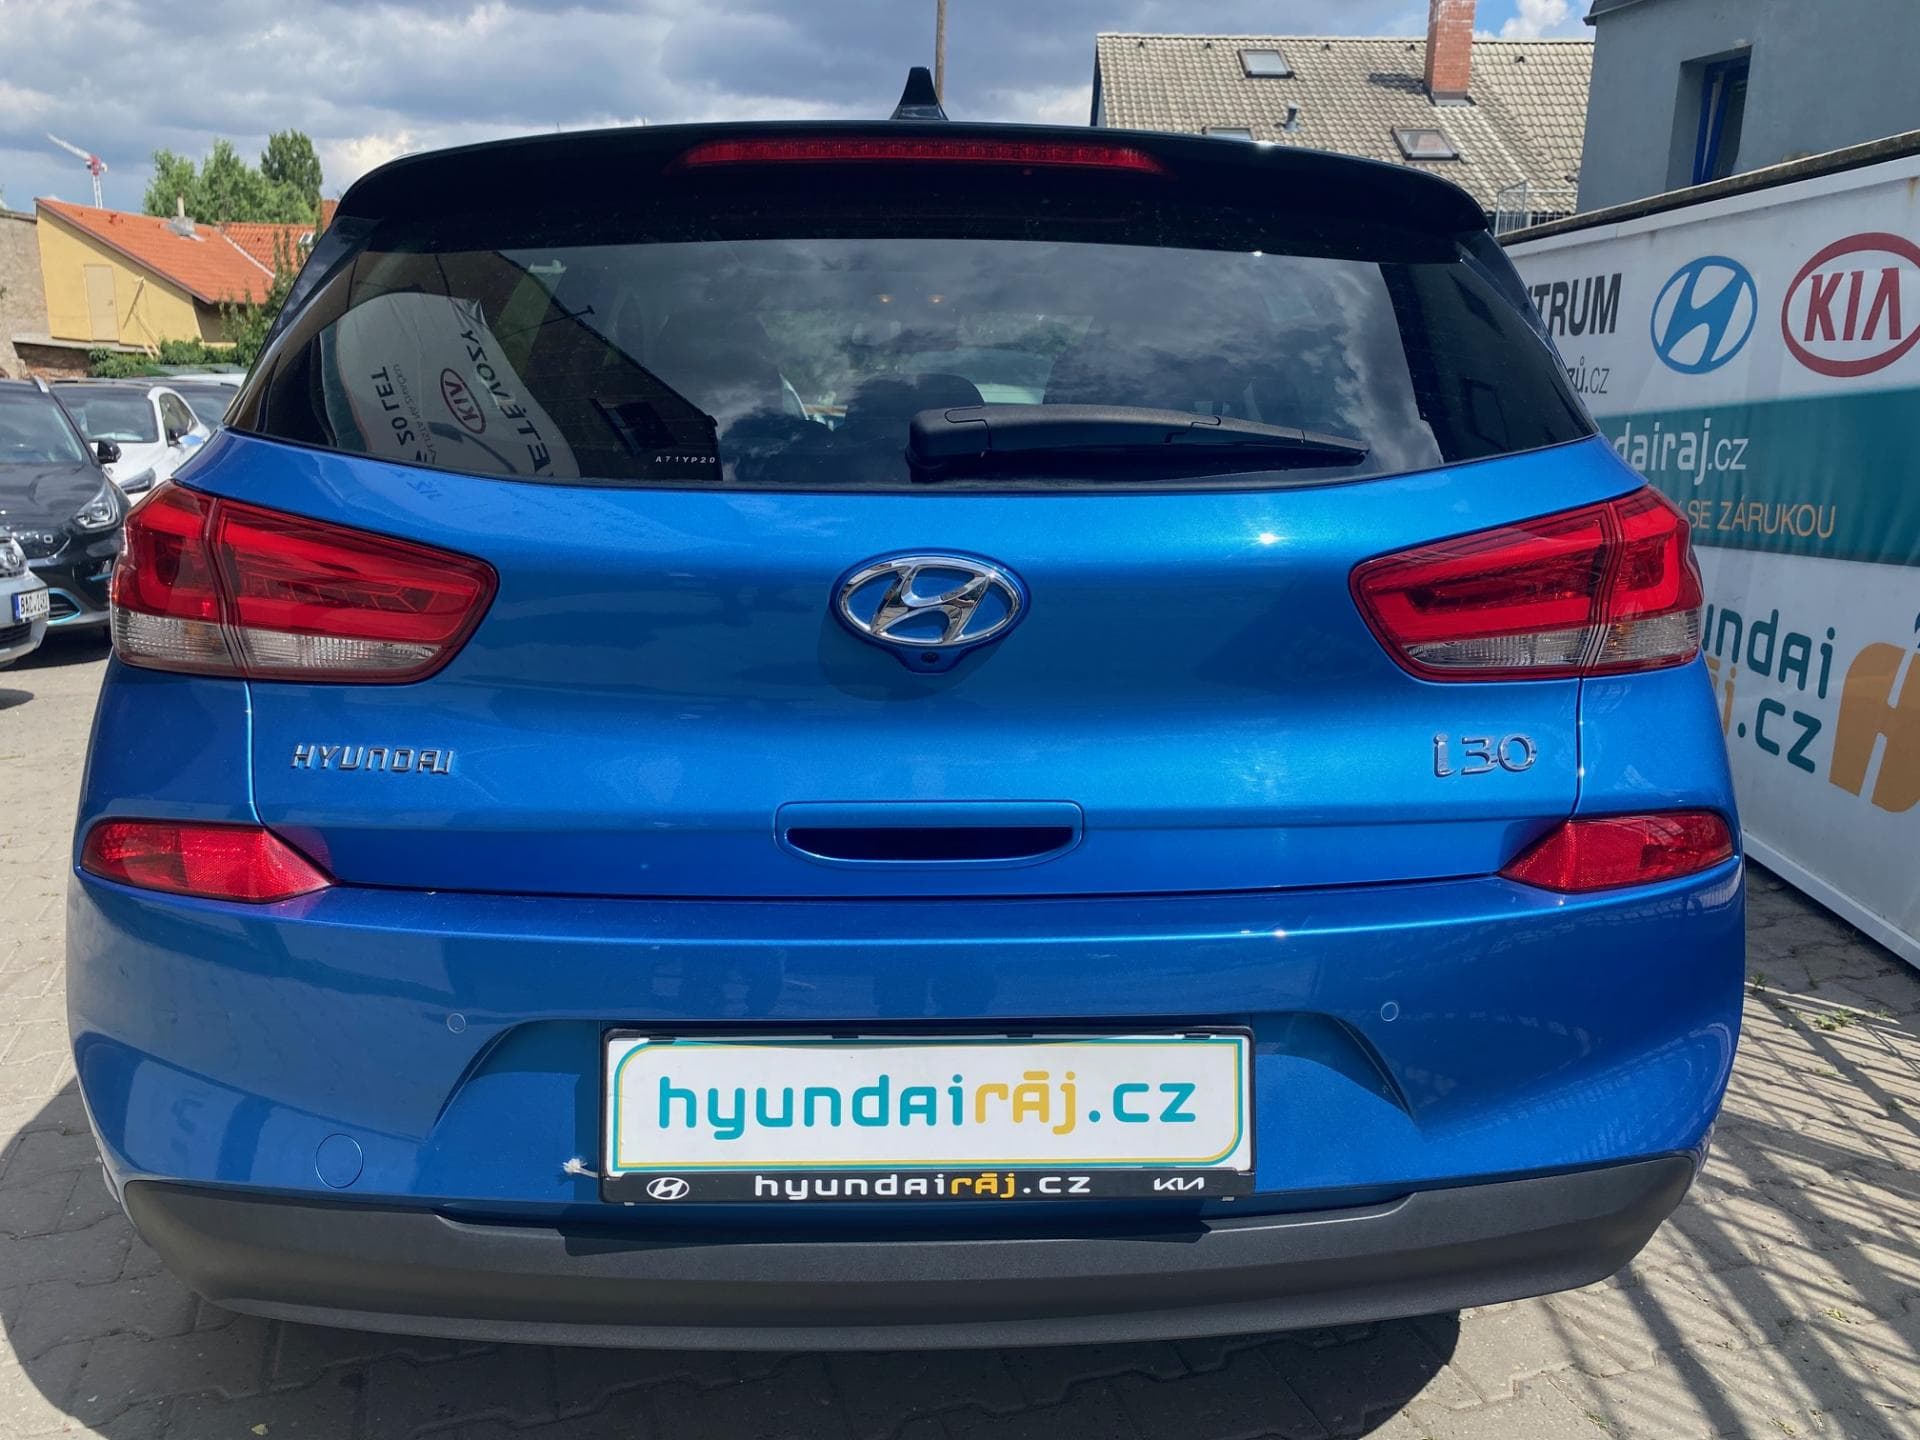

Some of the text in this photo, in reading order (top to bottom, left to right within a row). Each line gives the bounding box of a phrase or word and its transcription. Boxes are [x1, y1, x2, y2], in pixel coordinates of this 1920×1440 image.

[1529, 273, 1622, 337] TRUM
[1804, 267, 1902, 342] KIA
[1687, 494, 1836, 539] SE ZÁRUKOU
[291, 744, 454, 775] HYUNDAI
[1433, 734, 1537, 778] i30
